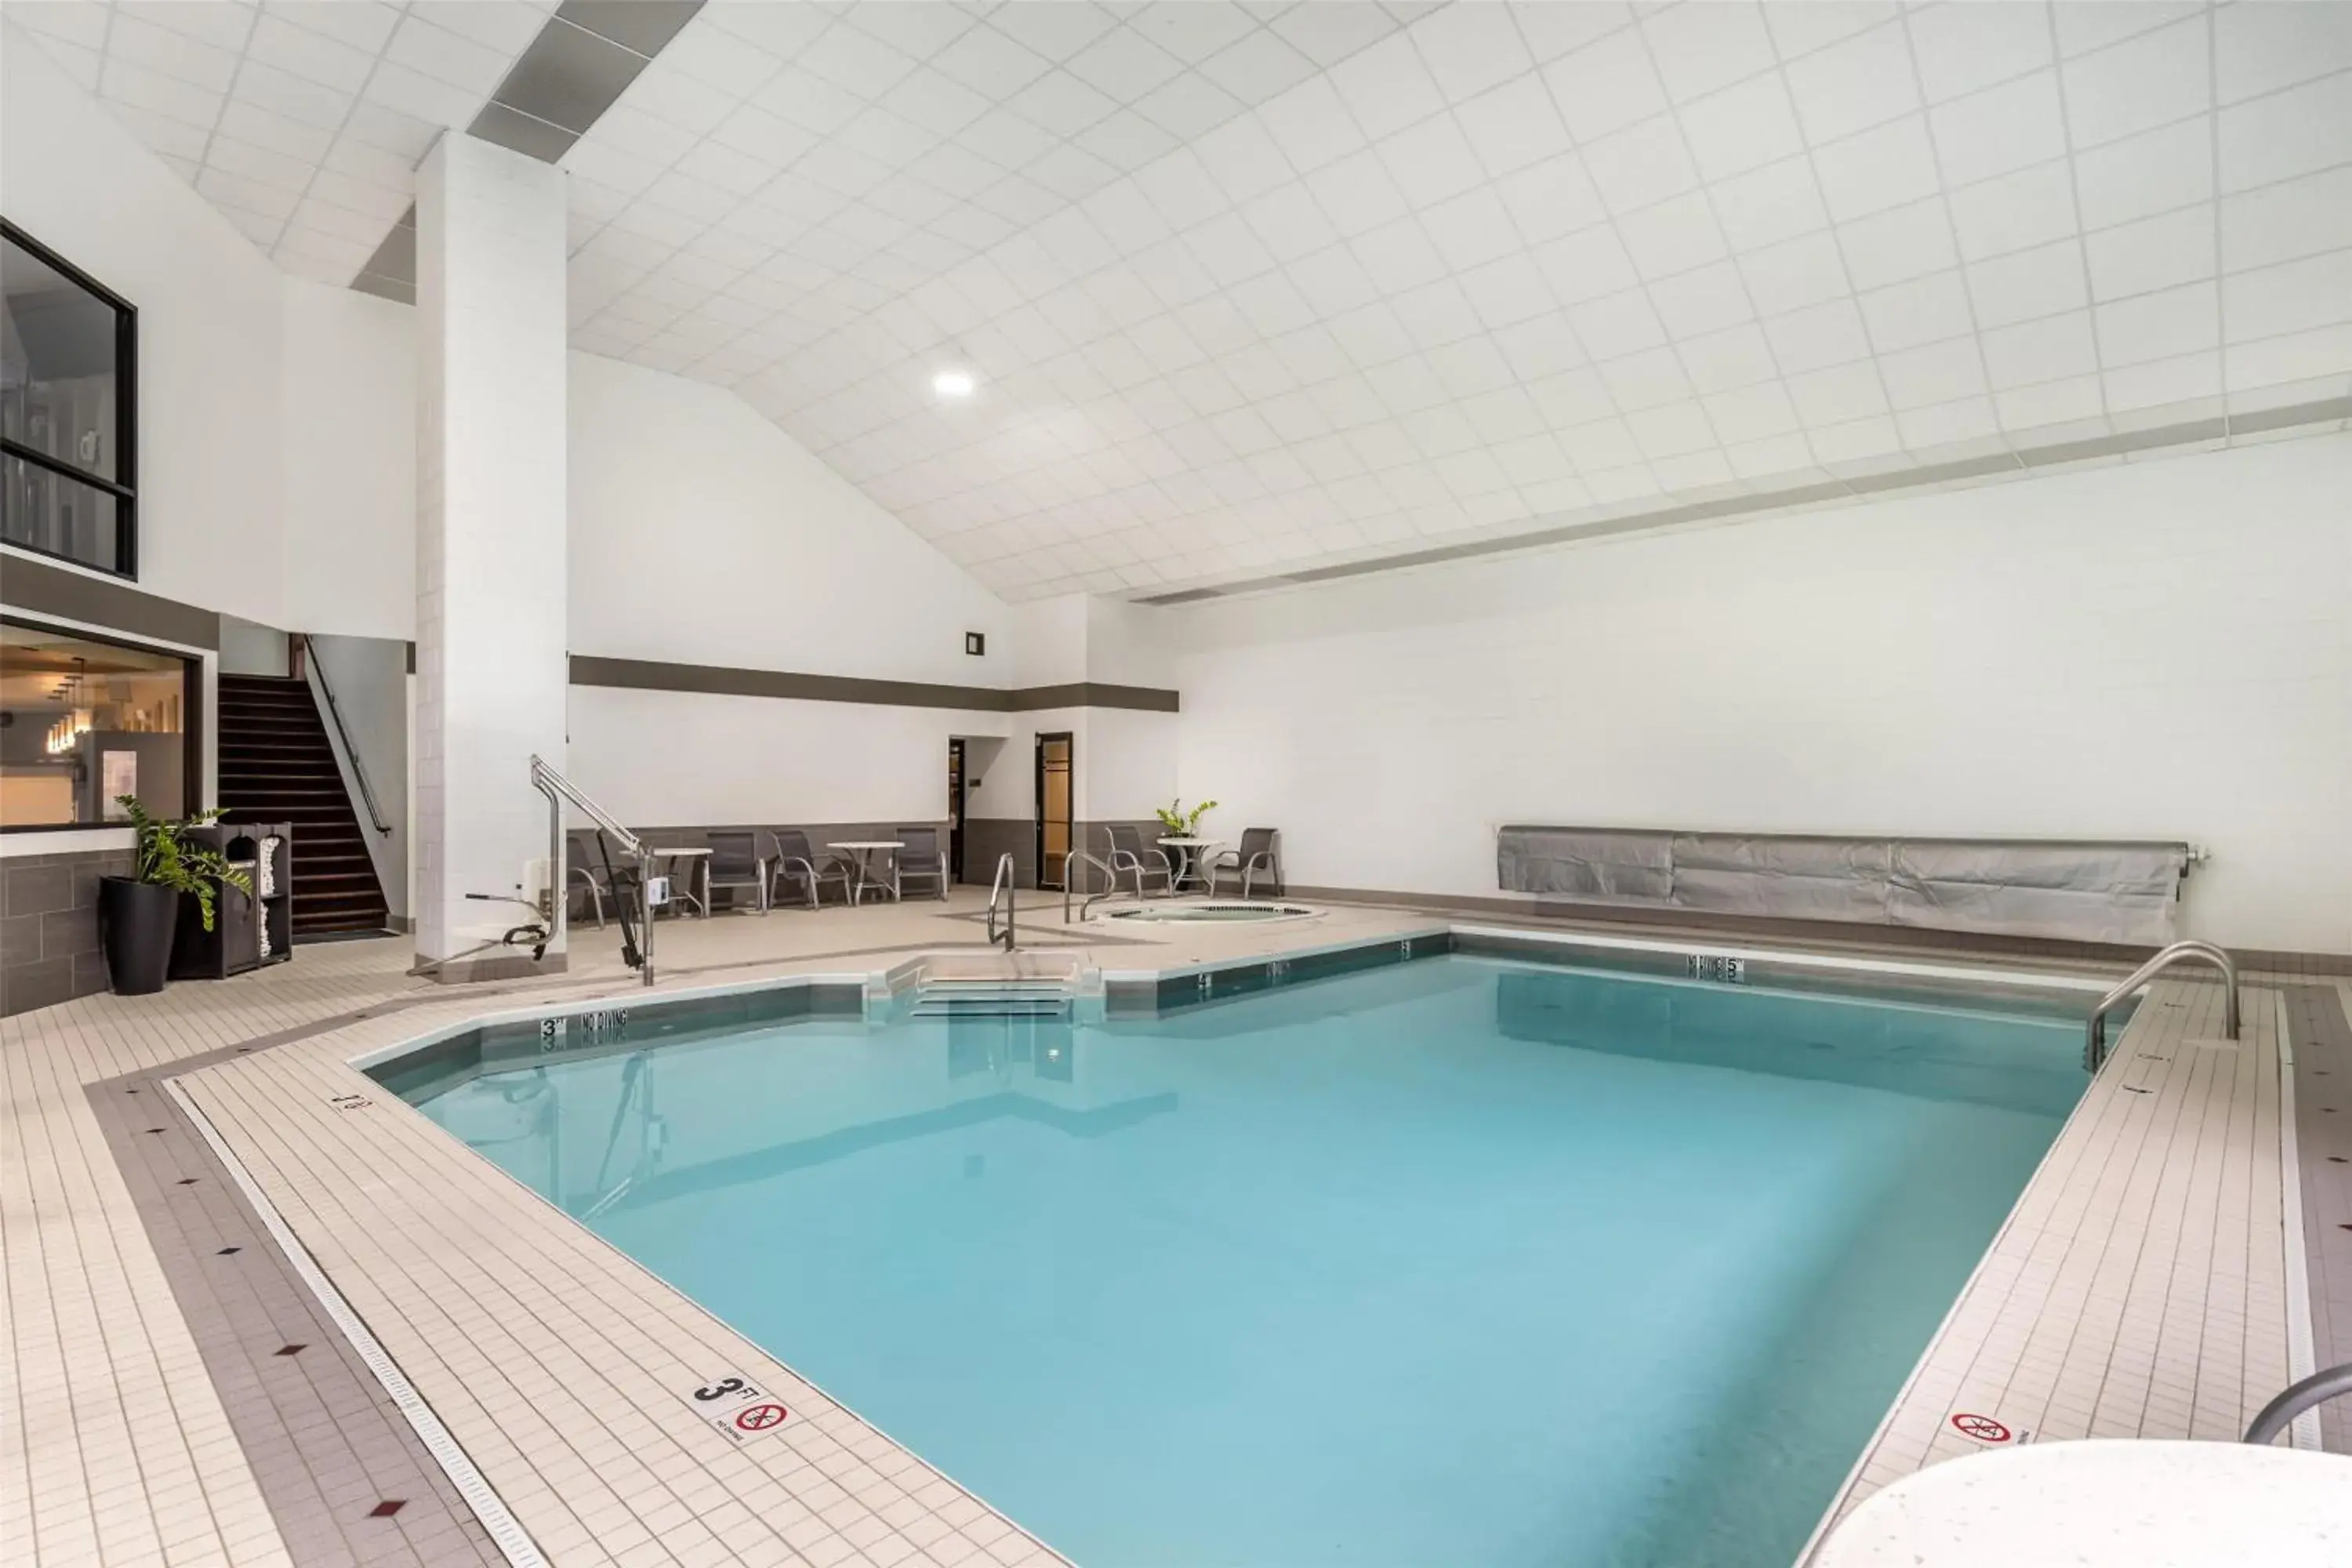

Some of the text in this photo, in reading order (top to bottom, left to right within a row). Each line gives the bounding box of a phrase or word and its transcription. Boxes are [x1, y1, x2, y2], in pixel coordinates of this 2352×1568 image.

[1727, 959, 1737, 971] 5
[543, 1020, 555, 1036] 3
[583, 1009, 627, 1032] NO DIVING
[694, 1377, 760, 1401] 3 FT
